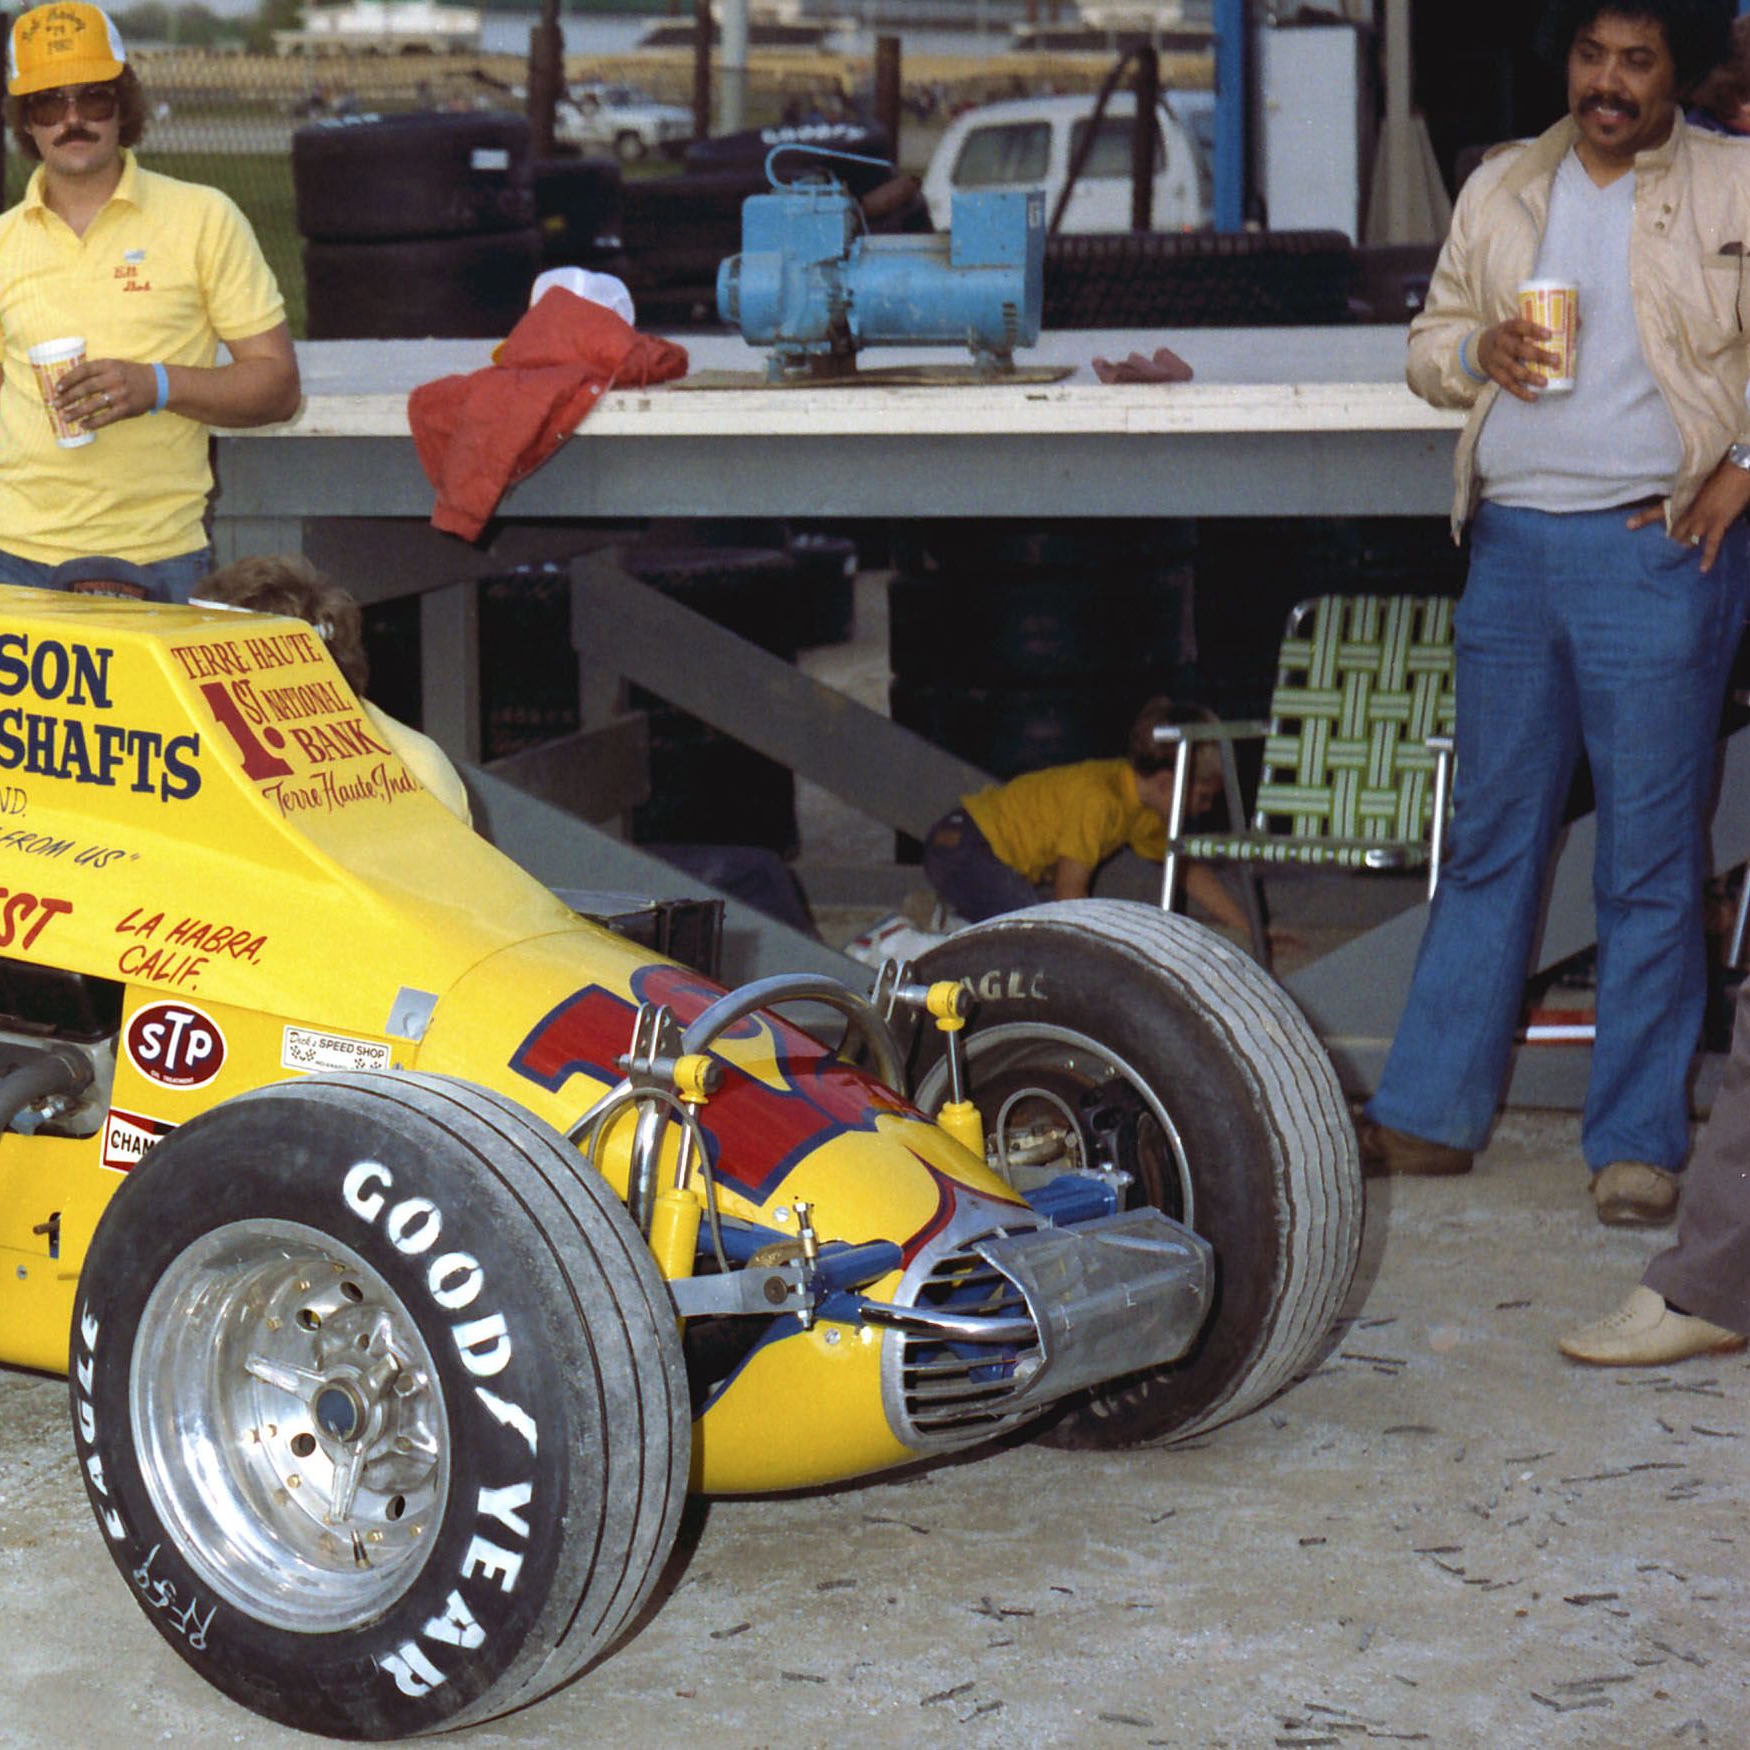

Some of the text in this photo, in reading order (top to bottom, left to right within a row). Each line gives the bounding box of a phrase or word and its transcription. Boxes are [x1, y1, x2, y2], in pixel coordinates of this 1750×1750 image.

[170, 633, 324, 680] TERRE HAUTE
[260, 681, 354, 722] NATIONAL
[289, 718, 392, 764] BANK
[262, 780, 322, 819] Terre
[115, 908, 268, 966] LA HABRA,
[118, 944, 209, 991] CALIF.
[138, 1010, 212, 1070] STP
[318, 1038, 354, 1053] SPEED
[356, 1046, 385, 1059] SHOP
[110, 1129, 156, 1156] CHAM
[77, 1296, 128, 1541] EAGLE
